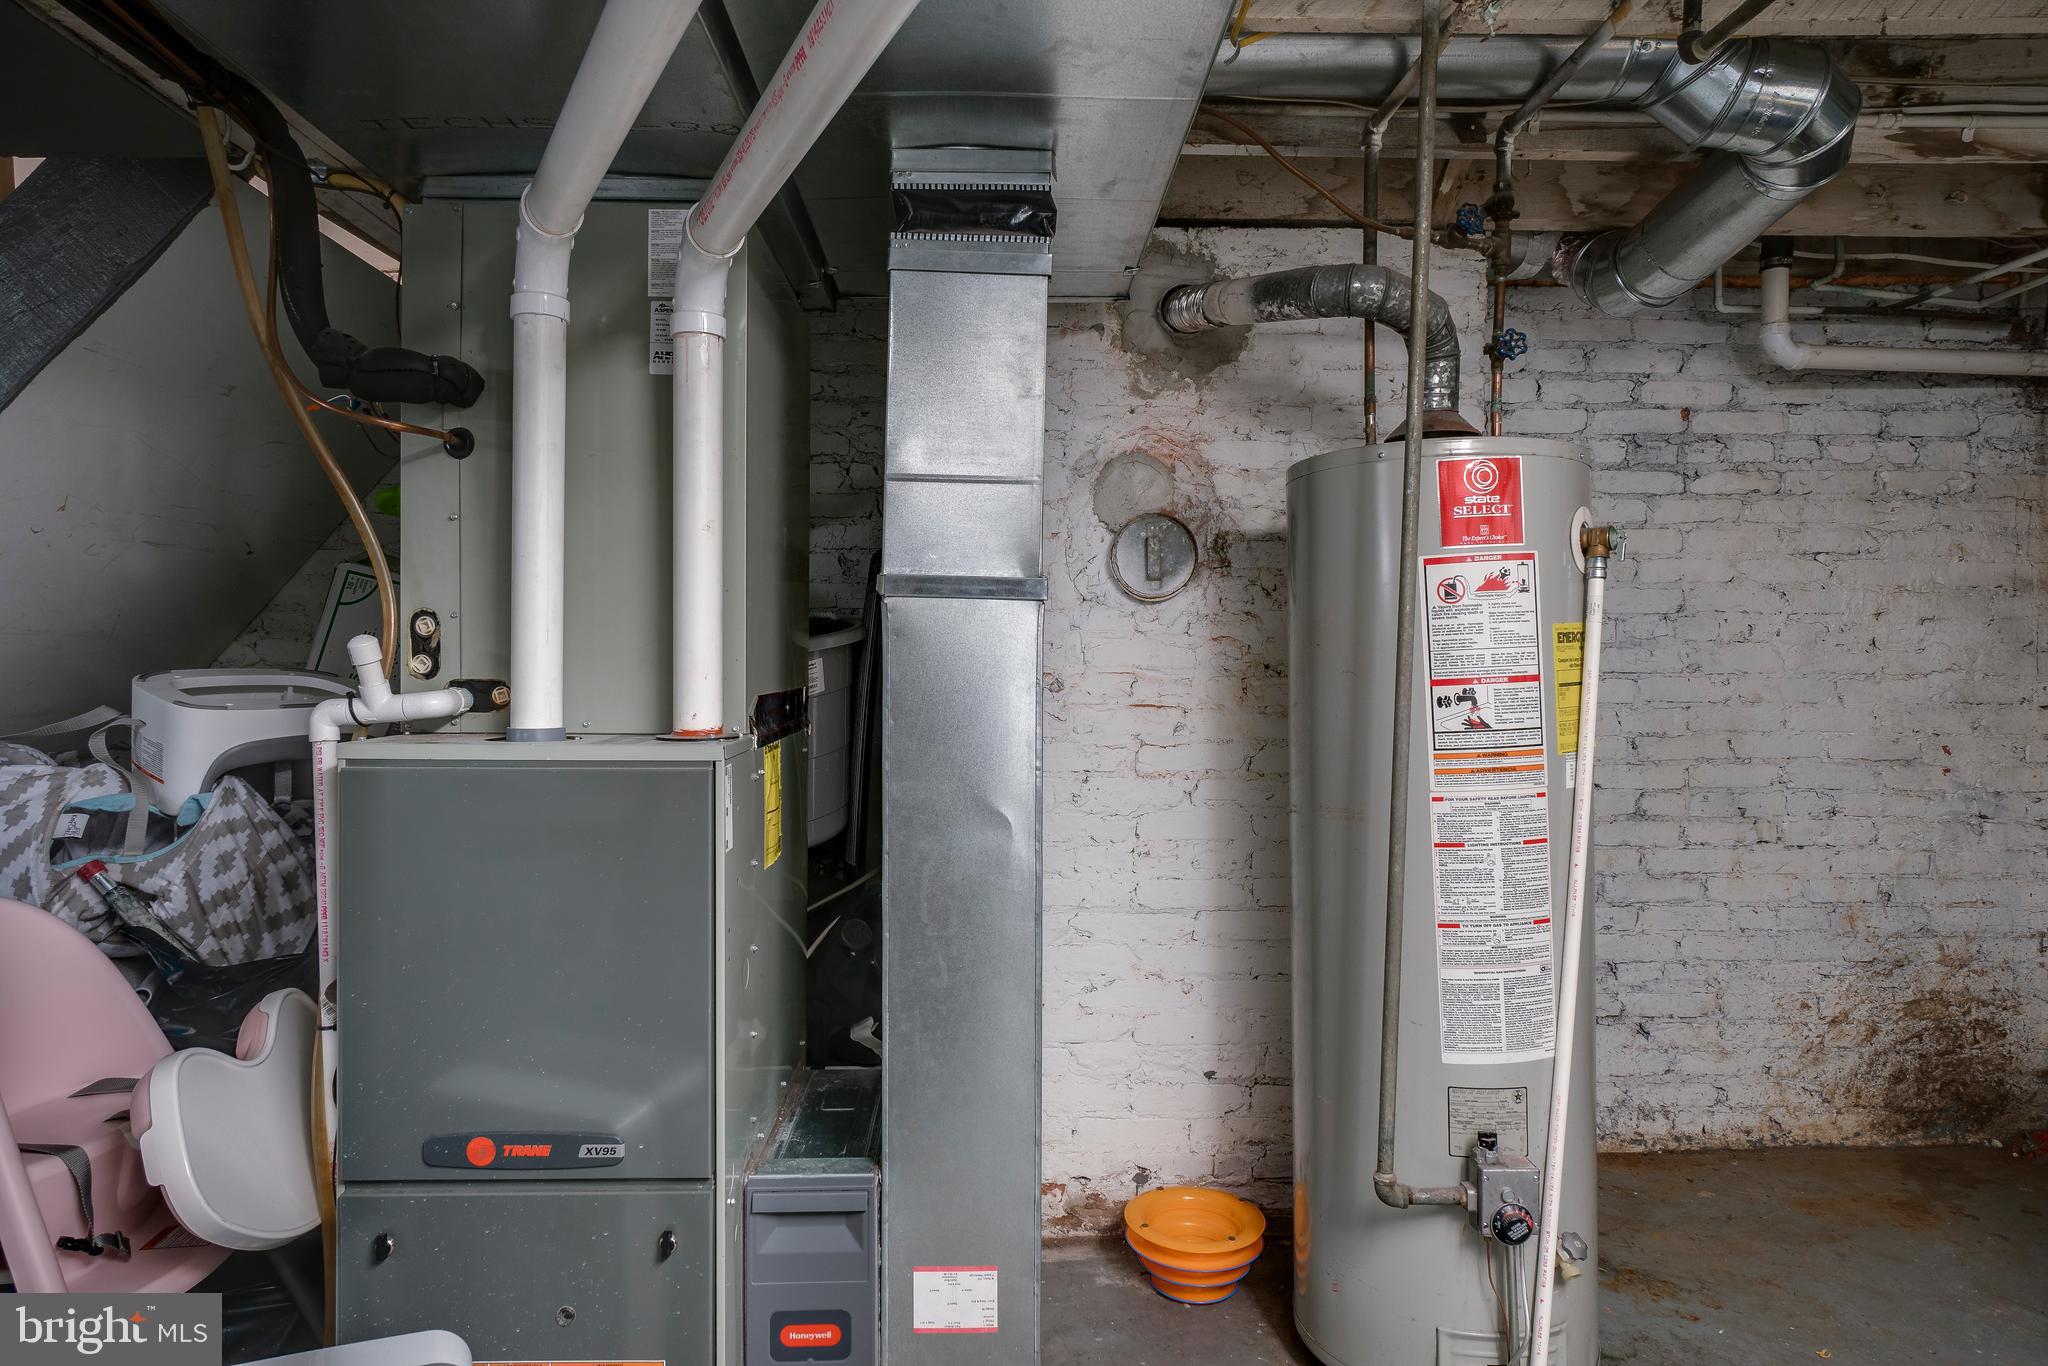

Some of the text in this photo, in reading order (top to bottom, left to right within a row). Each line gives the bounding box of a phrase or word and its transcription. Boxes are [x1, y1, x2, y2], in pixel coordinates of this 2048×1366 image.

[1464, 495, 1500, 504] state
[1453, 504, 1510, 516] SELECT
[316, 766, 324, 787] WATER
[503, 1144, 553, 1157] TRANE
[584, 1147, 617, 1156] XV95
[789, 1331, 832, 1341] Honeywell
